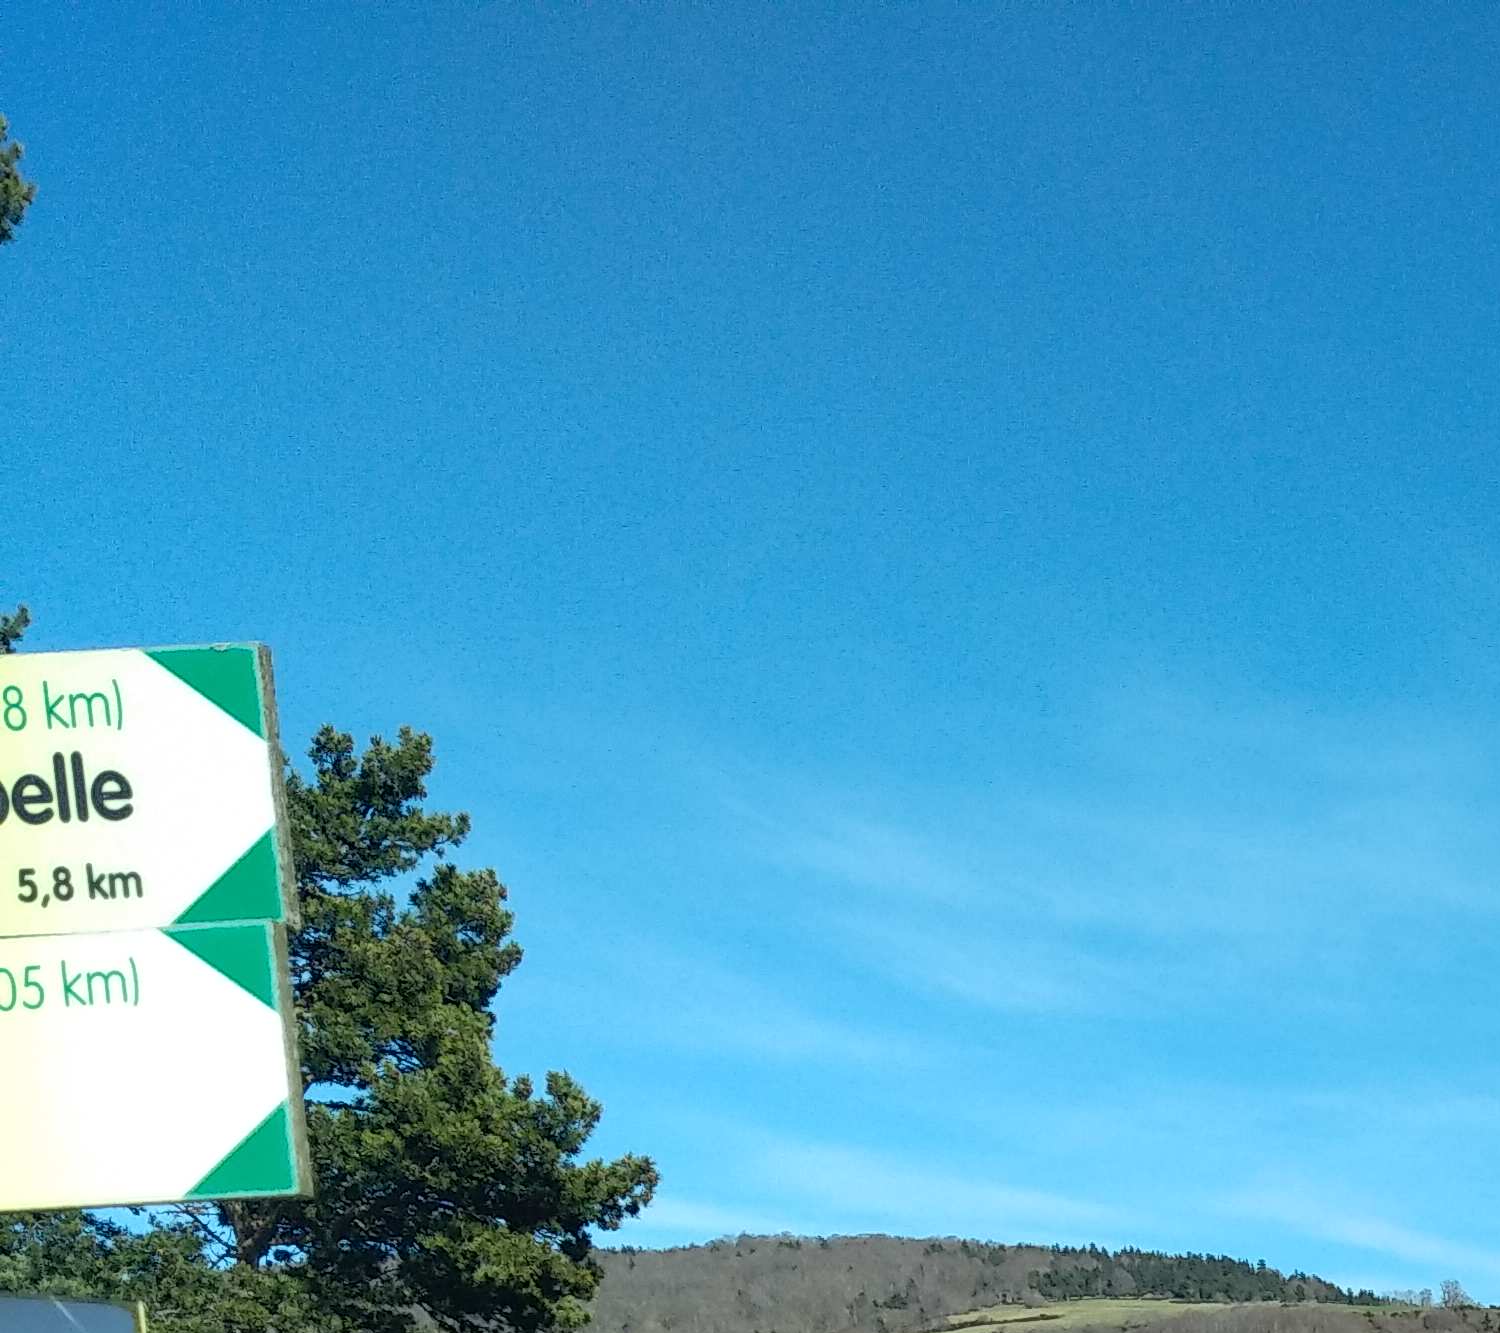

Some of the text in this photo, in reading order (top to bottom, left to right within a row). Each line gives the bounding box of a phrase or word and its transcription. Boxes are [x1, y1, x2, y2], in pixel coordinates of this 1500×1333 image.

[2, 678, 124, 731] 8 km)
[0, 750, 134, 826] elle
[17, 862, 144, 909] 5,8 km
[61, 957, 139, 1007] km)
